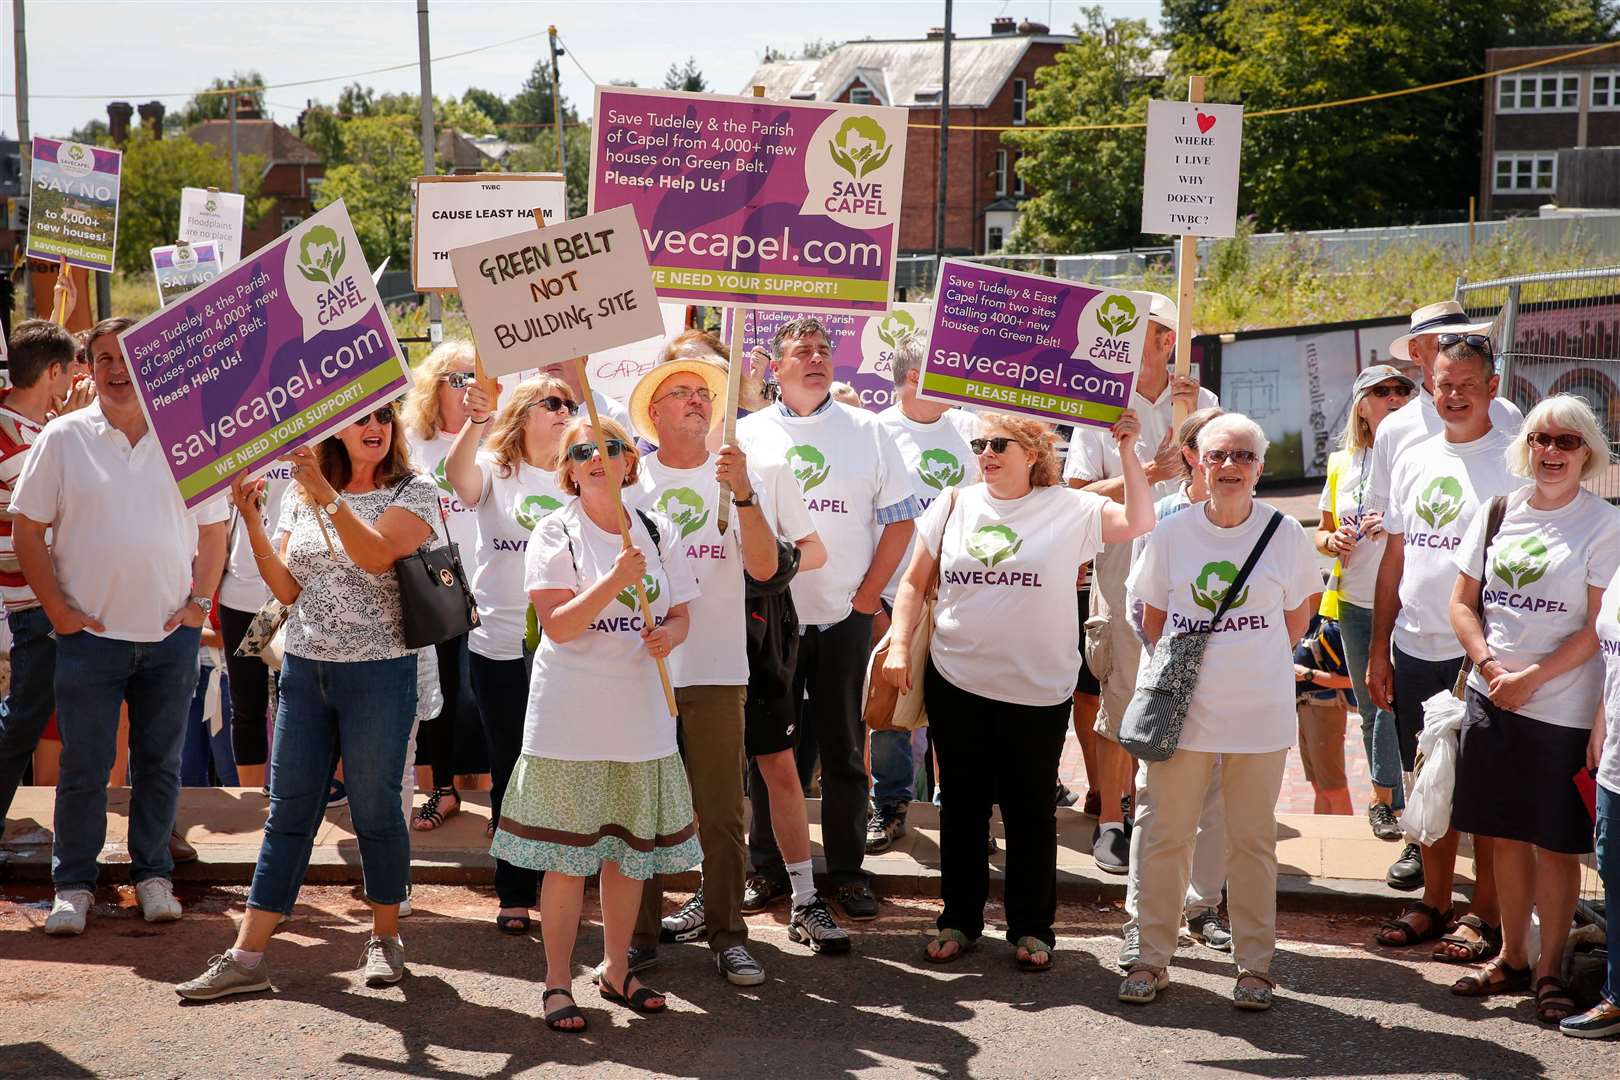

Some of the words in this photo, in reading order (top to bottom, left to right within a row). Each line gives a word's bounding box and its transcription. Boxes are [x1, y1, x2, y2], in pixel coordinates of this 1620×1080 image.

[608, 110, 642, 126] Save
[647, 112, 704, 133] Tudeley
[708, 118, 718, 130] &
[723, 118, 747, 132] the
[751, 120, 794, 136] Parish
[1182, 116, 1185, 125] I
[608, 131, 622, 144] of
[626, 131, 669, 150] Capel
[673, 133, 706, 149] from
[712, 137, 762, 154] 4,000+
[766, 145, 796, 156] new
[1174, 136, 1216, 146] WHERE
[606, 148, 657, 165] houses
[662, 156, 680, 167] on
[686, 157, 731, 171] Green
[736, 160, 768, 174] Belt.
[1176, 155, 1179, 164] I
[1185, 156, 1211, 166] LIVE
[38, 174, 74, 194] SAY
[80, 183, 112, 201] NO
[604, 172, 654, 188] Please
[659, 174, 696, 193] Help
[700, 178, 726, 192] Us!
[832, 181, 882, 199] SAVE
[1179, 176, 1206, 184] WHY
[824, 198, 887, 216] CAPEL
[1168, 194, 1216, 204] DOESN'T
[45, 209, 57, 218] to
[60, 211, 100, 227] 4,000+
[188, 216, 232, 230] Floodplains
[432, 210, 472, 220] CAUSE
[476, 209, 514, 218] LEAST
[517, 209, 553, 218] HAM
[1170, 214, 1209, 224] TWBC?
[36, 222, 60, 233] new
[63, 224, 106, 242] houses!
[212, 232, 233, 241] place
[34, 240, 107, 261] savecapel.com
[479, 243, 550, 285] GREEN
[554, 230, 614, 264] BELT
[642, 227, 882, 270] vecapel.com
[164, 274, 188, 288] SAY
[192, 271, 214, 283] NO
[530, 271, 578, 304] NOT
[670, 272, 712, 286] NEED
[717, 275, 760, 290] YOUR
[764, 278, 838, 294] SUPPORT!
[948, 275, 974, 289] Save
[978, 280, 1020, 298] Tudeley
[1022, 288, 1031, 298] &
[1034, 290, 1058, 304] East
[317, 276, 357, 309] SAVE
[318, 293, 366, 326] CAPEL
[946, 290, 978, 306] Capel
[981, 294, 1006, 308] from
[1009, 302, 1029, 314] two
[1032, 306, 1056, 319] sites
[134, 338, 160, 360] Save
[161, 314, 204, 345] Tudeley
[205, 305, 215, 317] &
[216, 291, 234, 310] the
[236, 272, 270, 297] Parish
[494, 304, 592, 350] BUILDING
[598, 289, 638, 318] SITE
[826, 314, 854, 324] Parish
[944, 304, 988, 322] totalling
[990, 312, 1024, 326] 4000+
[1027, 320, 1050, 332] new
[141, 360, 153, 376] of
[154, 343, 186, 367] Capel
[186, 328, 214, 350] from
[215, 307, 252, 331] 4,000+
[255, 288, 278, 308] new
[836, 328, 856, 336] new
[942, 317, 979, 334] houses
[982, 326, 996, 336] on
[999, 329, 1033, 345] Green
[1036, 335, 1061, 348] Belt!
[146, 363, 184, 392] houses
[186, 354, 201, 367] on
[202, 335, 238, 358] Green
[240, 317, 266, 338] Belt.
[1095, 336, 1130, 352] SAVE
[880, 352, 894, 360] SA
[1089, 347, 1132, 364] CAPEL
[152, 384, 190, 412] Please
[192, 364, 220, 388] Help
[224, 351, 244, 369] Us!
[933, 349, 1124, 398] savecapel.com
[171, 327, 384, 466] savecapel.com
[966, 383, 1017, 402] PLEASE
[1021, 394, 1056, 409] HELP
[1060, 400, 1084, 414] US!
[214, 457, 236, 476] WE
[236, 440, 270, 464] NEED
[271, 420, 306, 444] YOUR
[306, 382, 364, 426] SUPPORT!
[944, 570, 1042, 588] SAVECAPEL
[1484, 590, 1568, 612] AVECAPEL
[1172, 613, 1269, 633] SAVECAPEL
